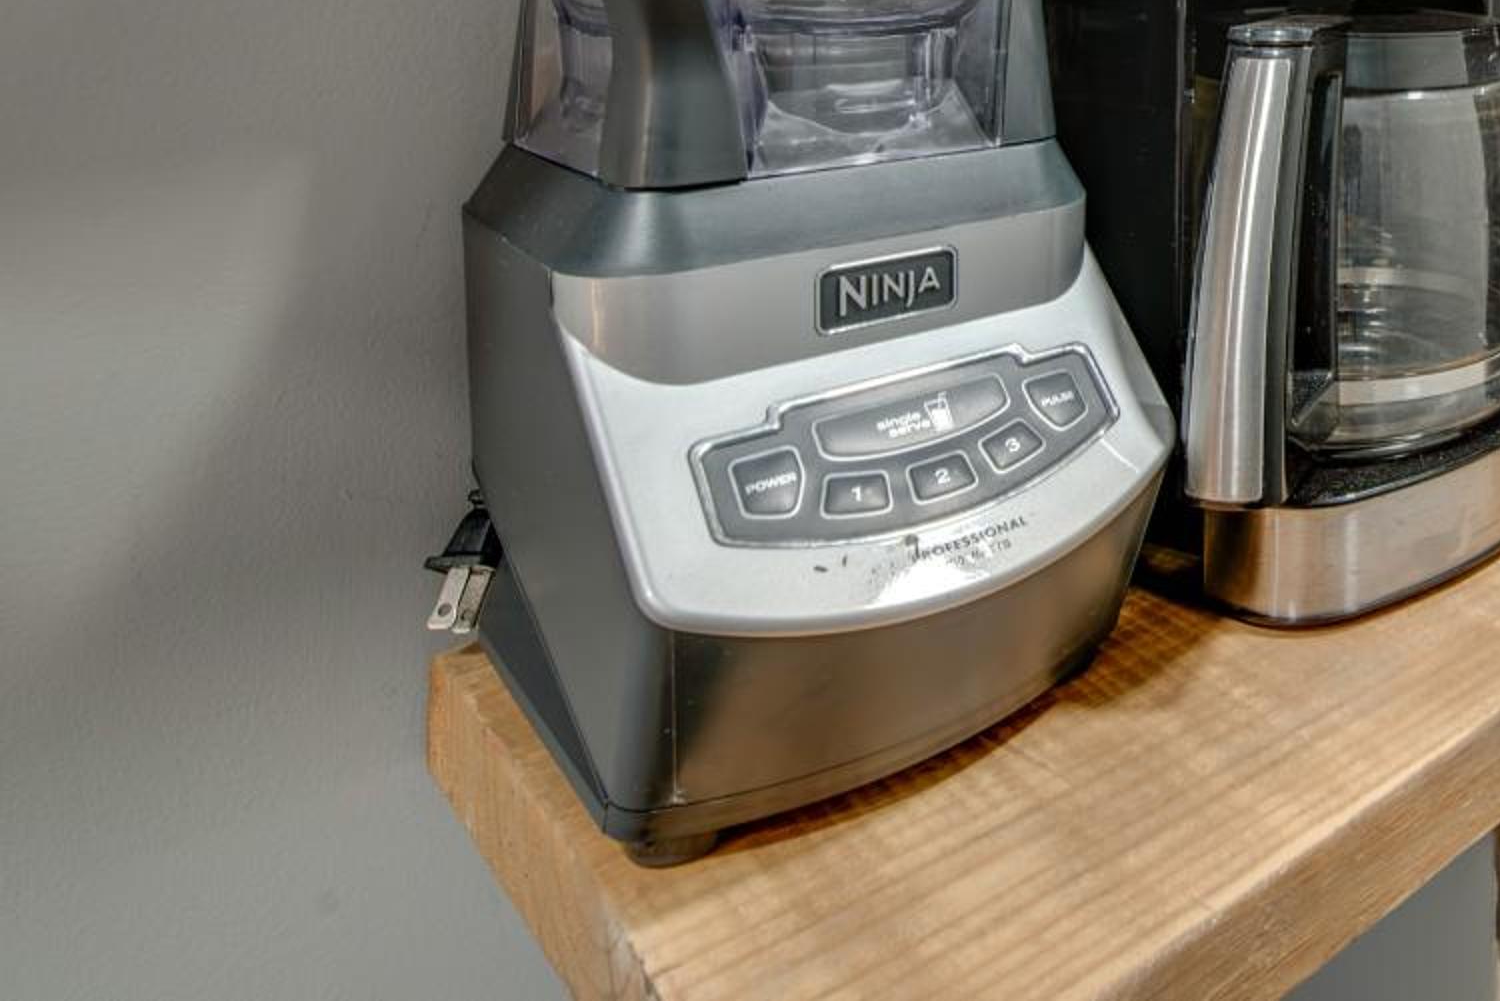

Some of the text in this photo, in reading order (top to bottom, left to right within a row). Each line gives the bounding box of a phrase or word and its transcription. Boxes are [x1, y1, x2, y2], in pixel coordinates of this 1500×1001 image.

[838, 266, 942, 317] NINJA
[876, 411, 922, 431] single
[889, 420, 931, 438] serve
[1005, 437, 1021, 453] 3
[744, 471, 797, 496] POWER
[935, 468, 952, 485] 2
[851, 486, 862, 501] 1
